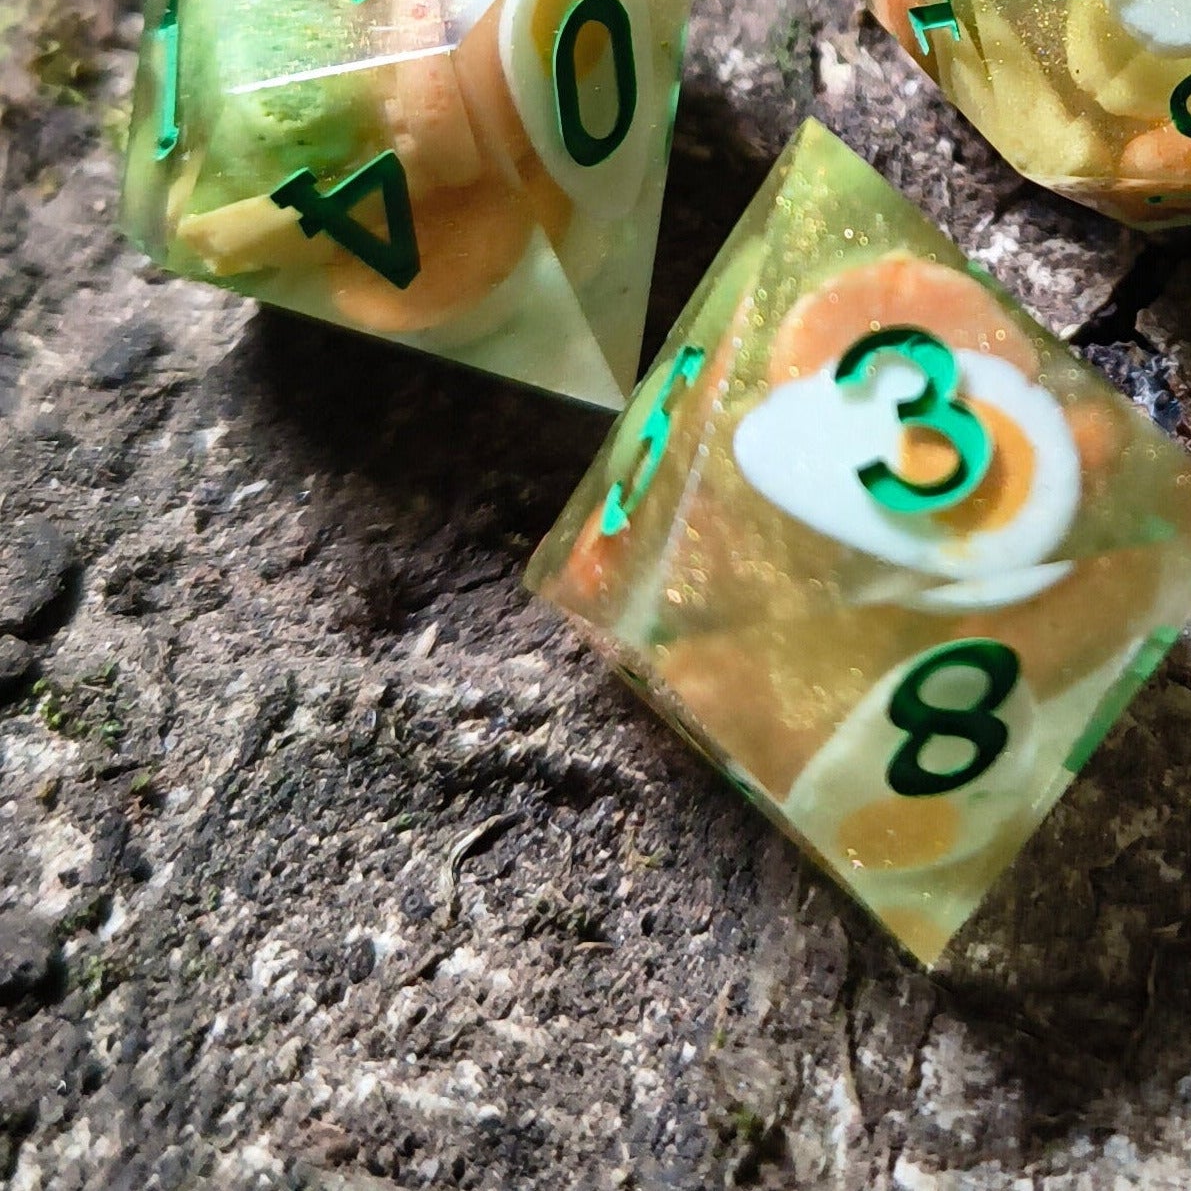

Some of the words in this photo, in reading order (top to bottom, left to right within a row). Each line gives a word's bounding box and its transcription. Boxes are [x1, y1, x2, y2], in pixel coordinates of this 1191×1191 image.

[268, 149, 422, 291] 4
[833, 323, 993, 514] 3
[885, 636, 1023, 797] 8
